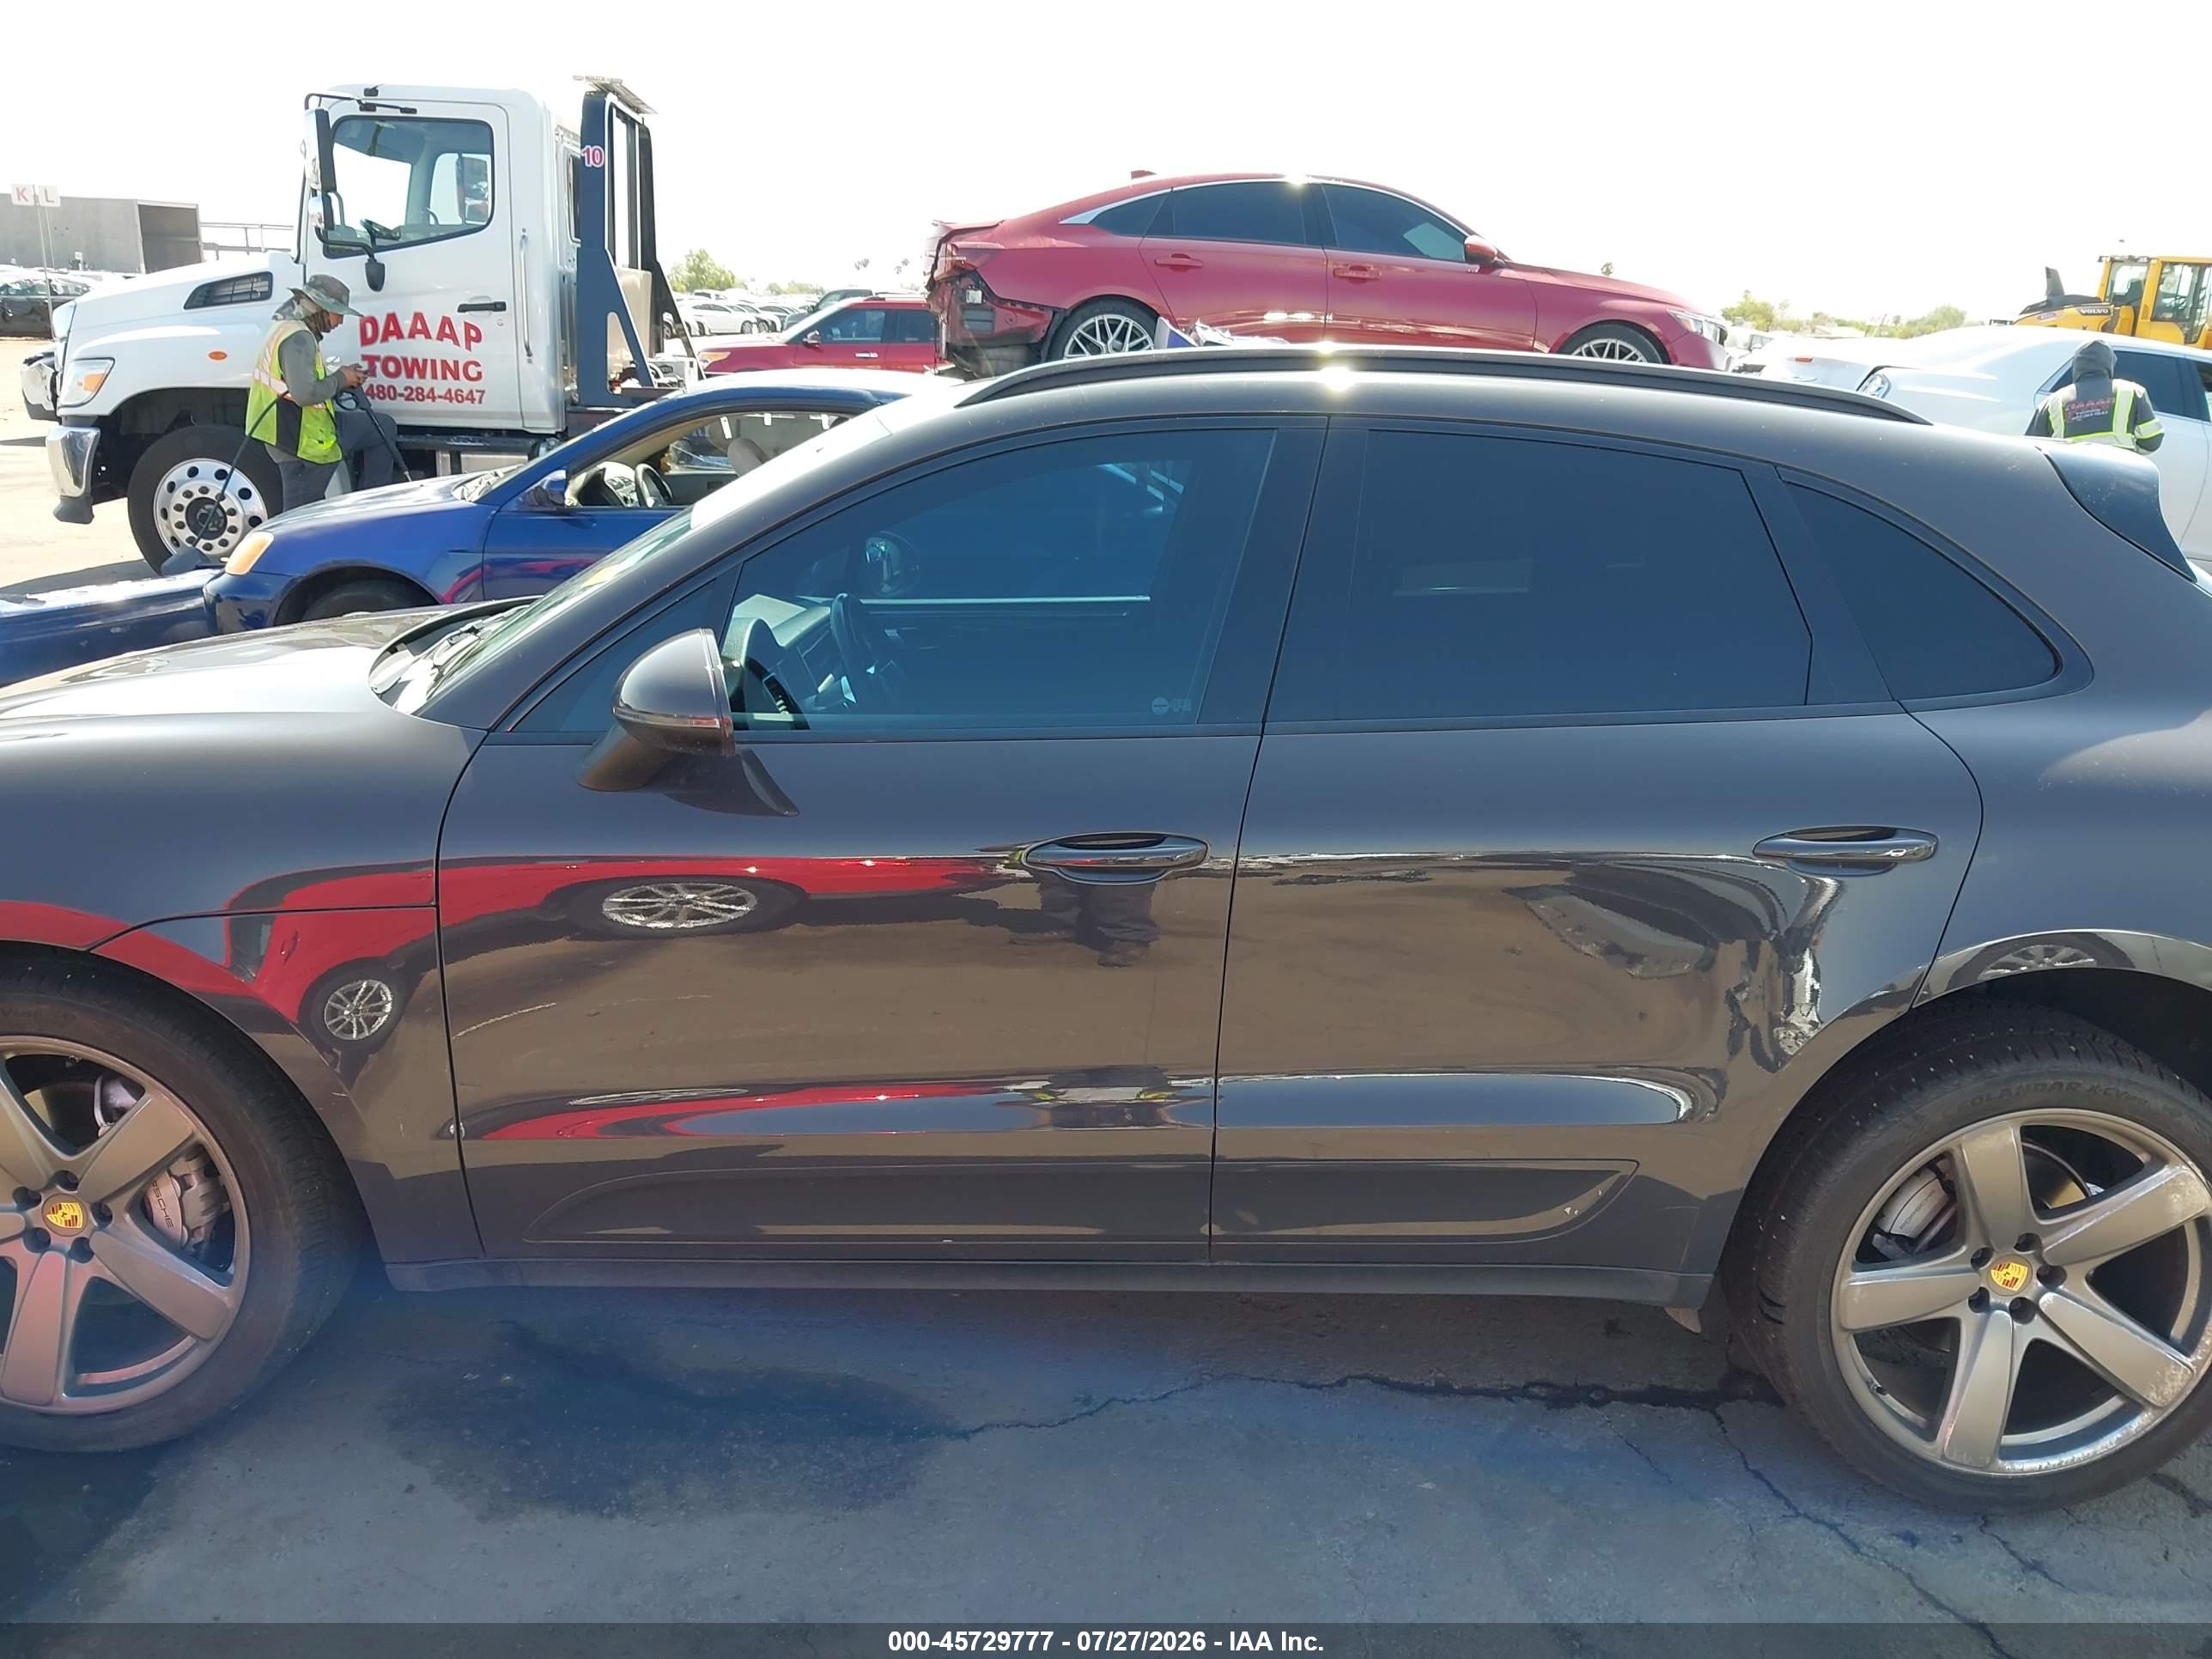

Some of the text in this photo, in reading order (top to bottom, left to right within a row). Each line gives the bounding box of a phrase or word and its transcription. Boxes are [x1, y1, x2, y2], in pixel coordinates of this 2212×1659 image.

[580, 145, 605, 167] 10
[15, 187, 28, 202] K
[44, 188, 55, 204] L
[359, 311, 483, 351] DAAAP
[361, 354, 483, 382] TOWING
[365, 384, 486, 404] 480-284-4647
